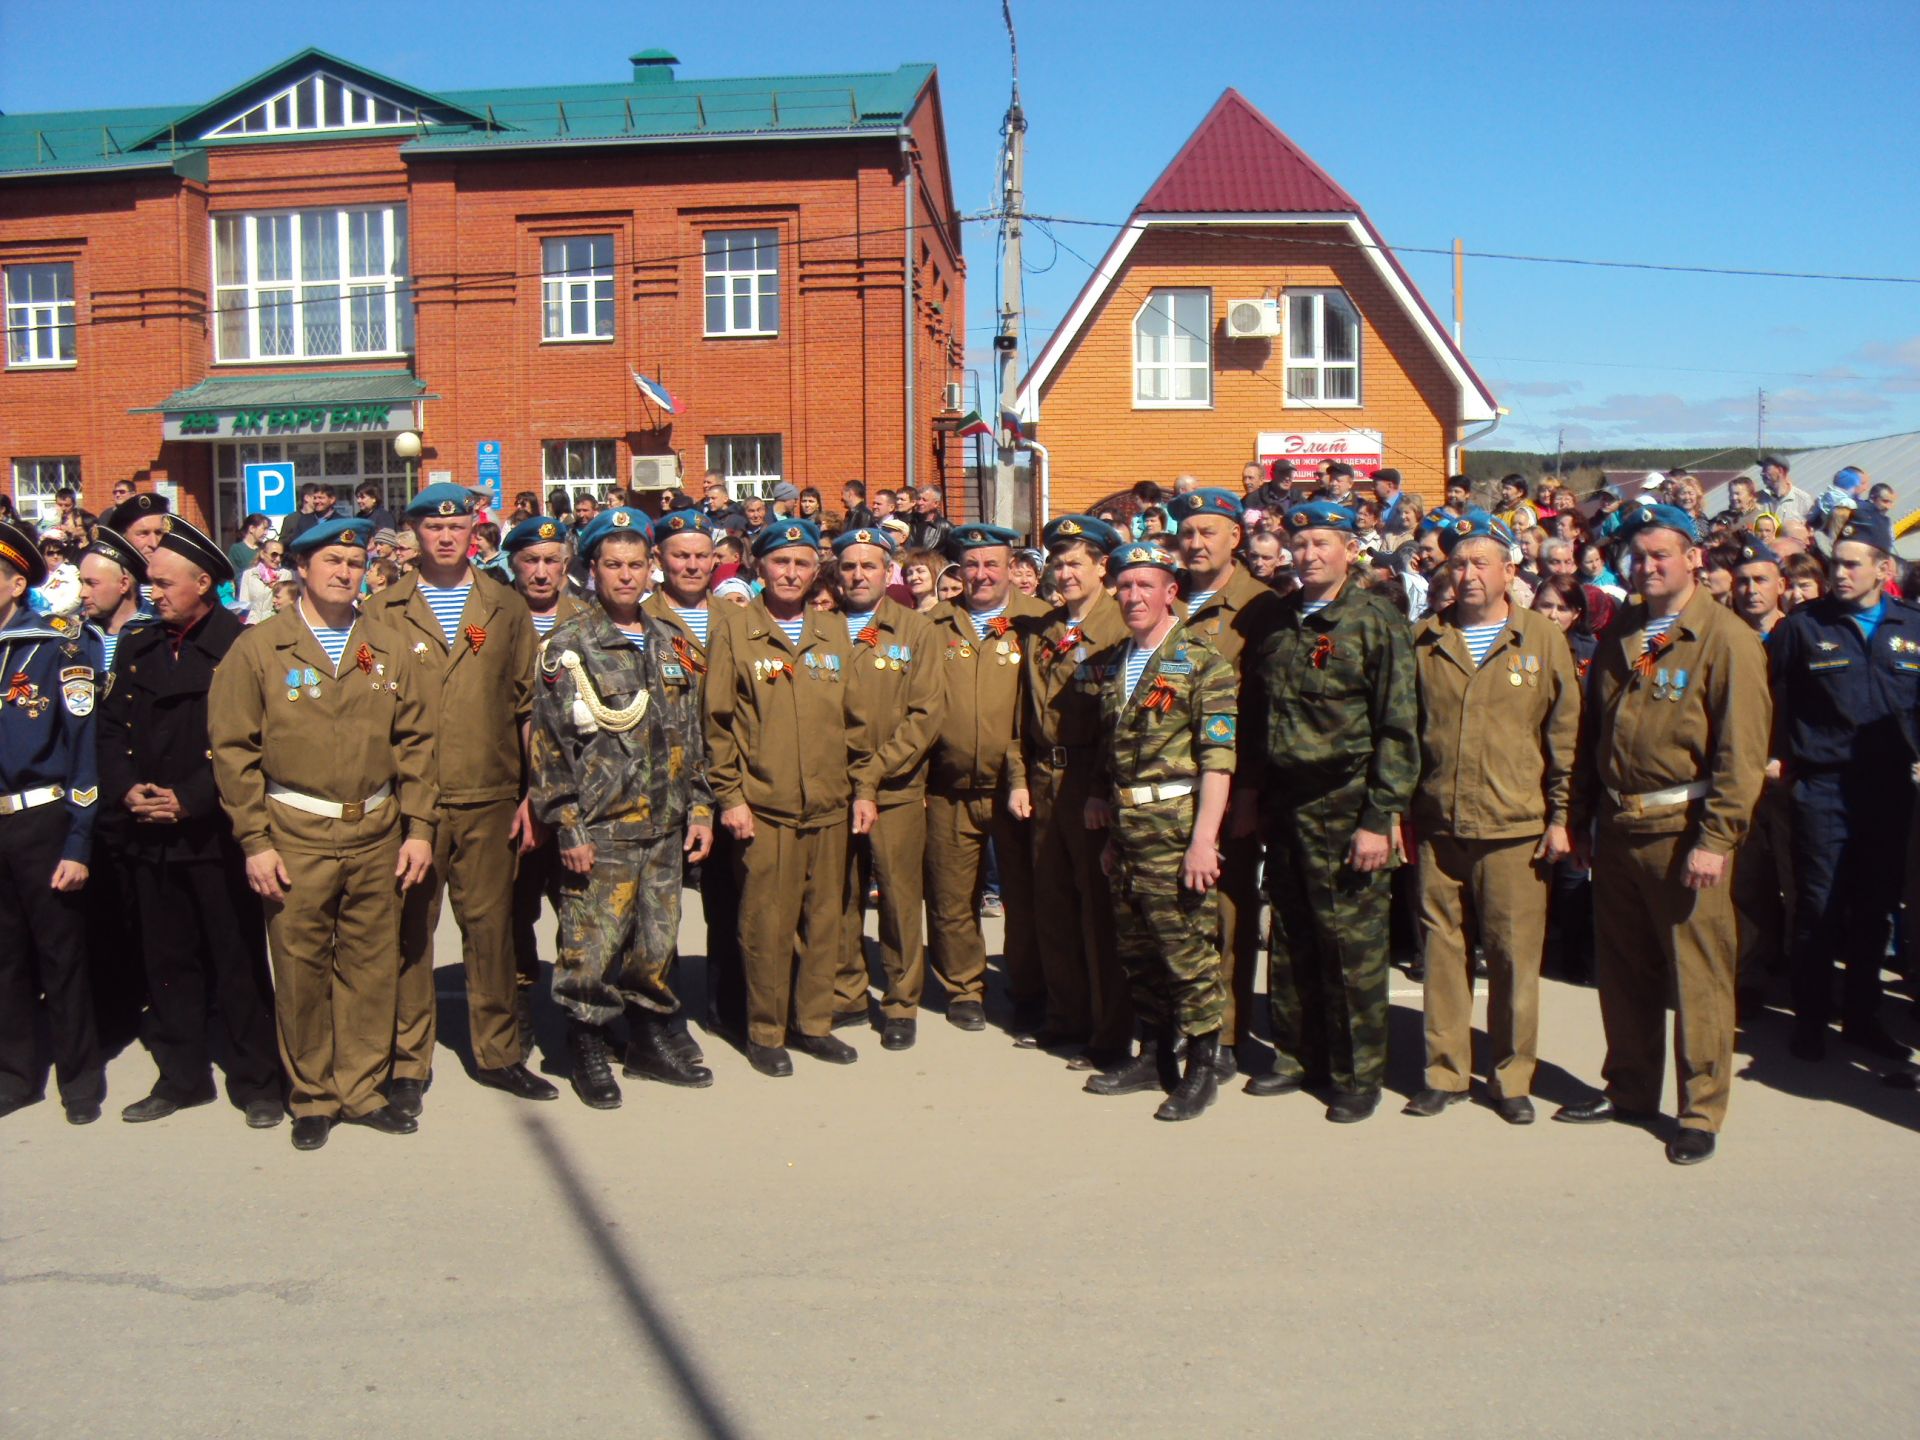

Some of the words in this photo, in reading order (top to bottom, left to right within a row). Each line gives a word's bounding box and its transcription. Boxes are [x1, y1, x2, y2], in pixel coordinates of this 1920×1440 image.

[232, 410, 264, 428] АК
[268, 407, 326, 427] БАРС
[330, 404, 391, 425] БАНК
[1285, 435, 1347, 453] Элит
[1343, 458, 1378, 466] ОДЕЖДА
[258, 470, 285, 511] P
